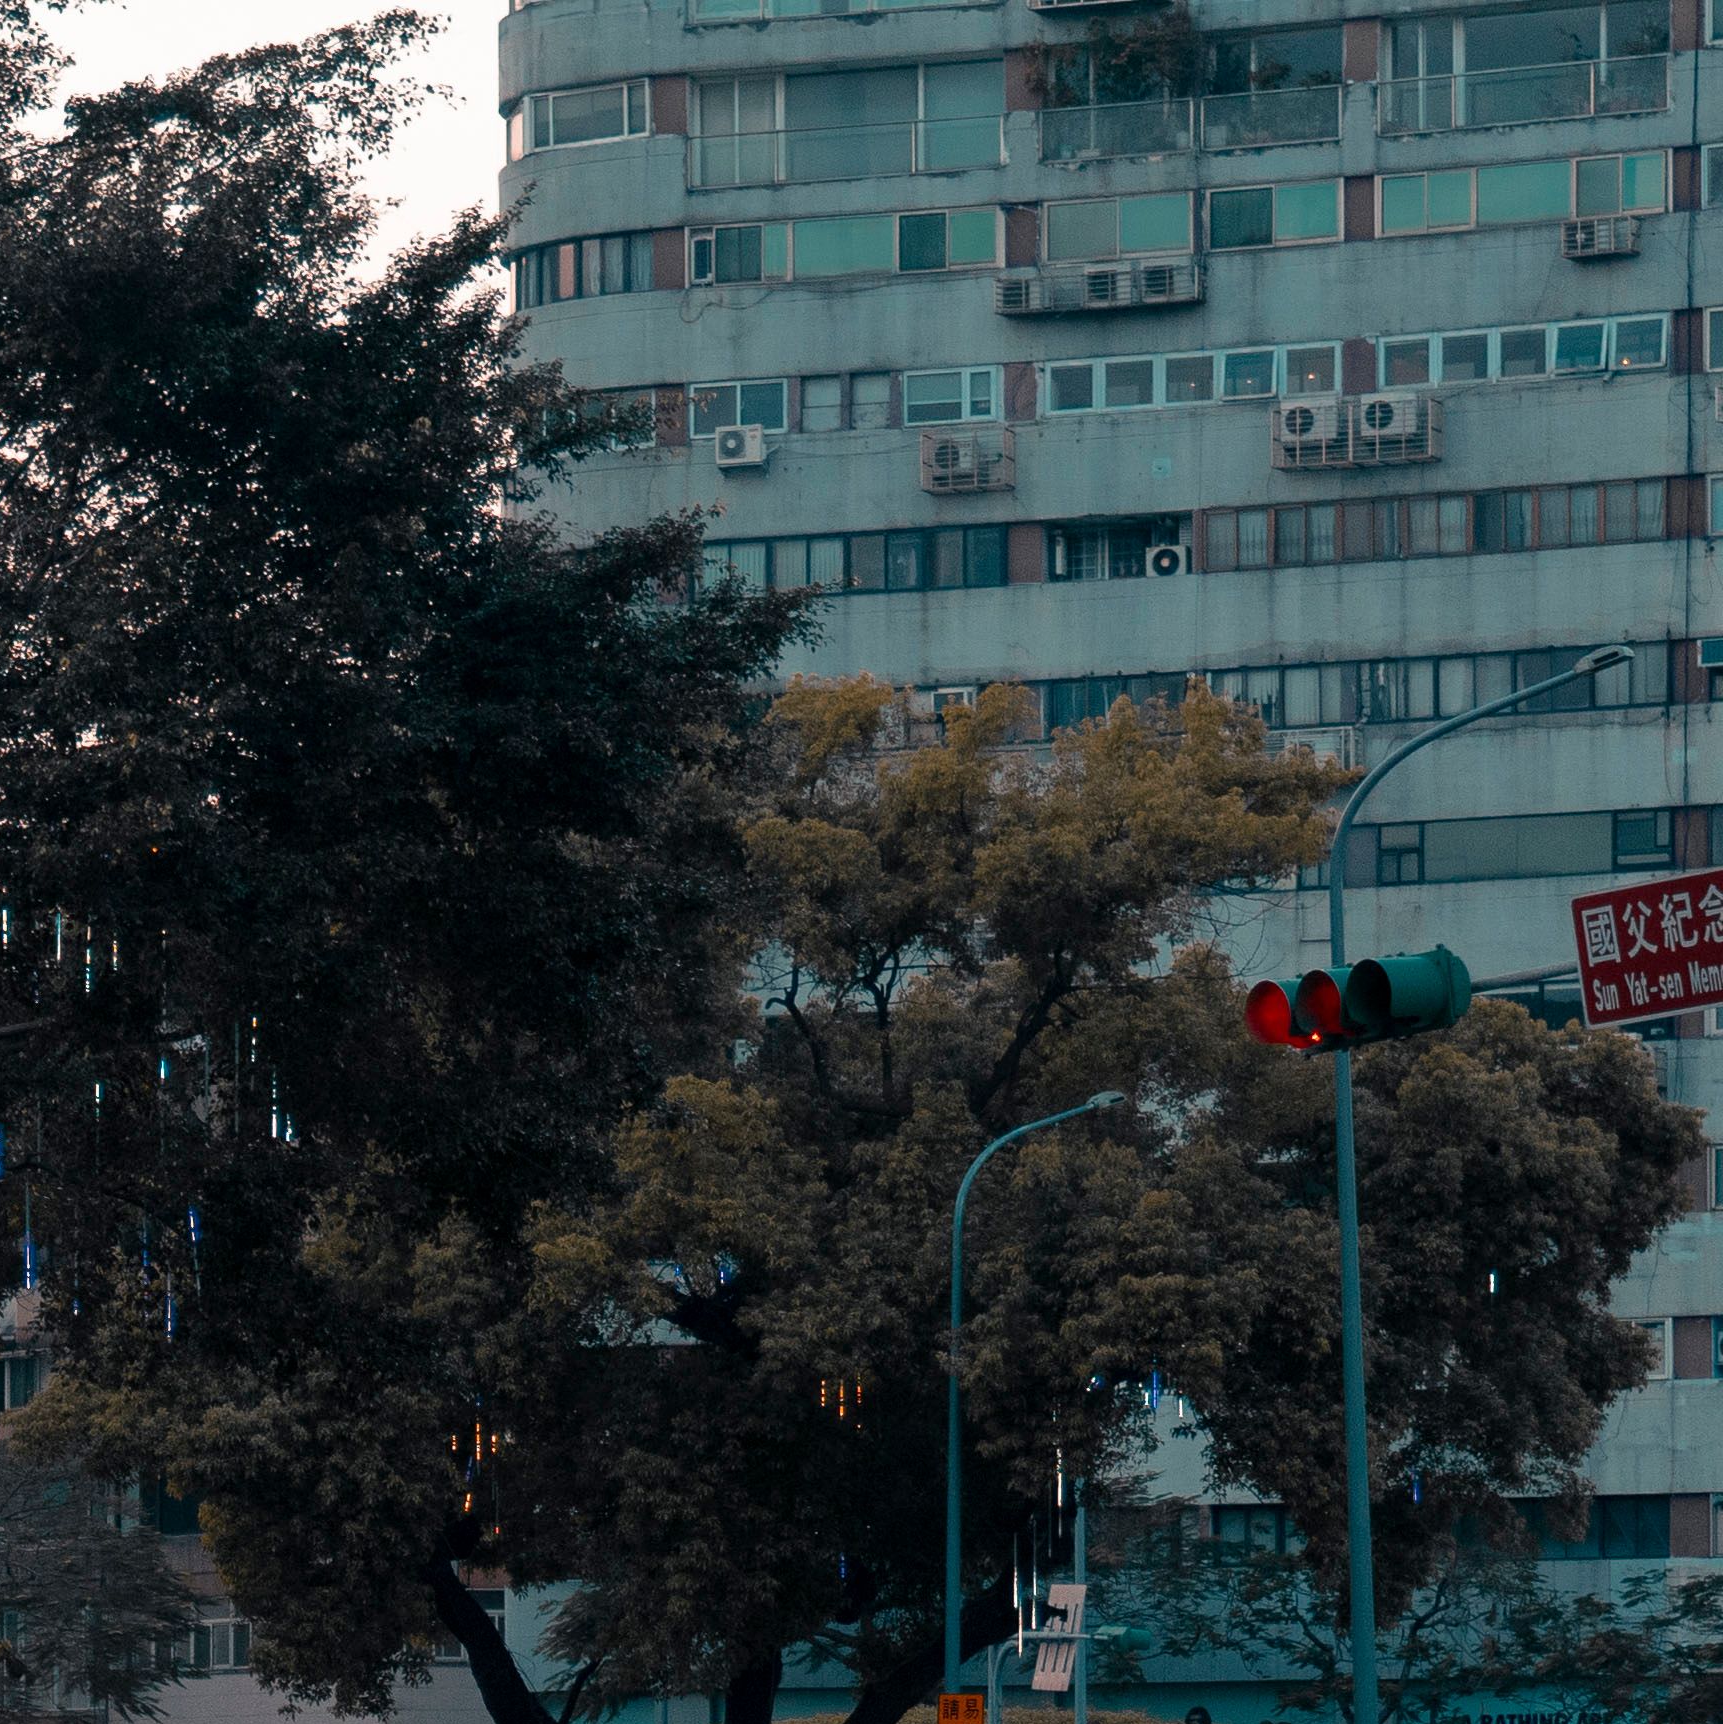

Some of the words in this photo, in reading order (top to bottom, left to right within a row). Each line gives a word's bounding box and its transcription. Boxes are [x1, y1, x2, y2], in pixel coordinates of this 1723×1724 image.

[1581, 883, 1723, 968] 國父紀念
[1592, 978, 1620, 1012] Sun
[1624, 971, 1685, 1007] Yat-sen
[1687, 960, 1723, 997] Mem
